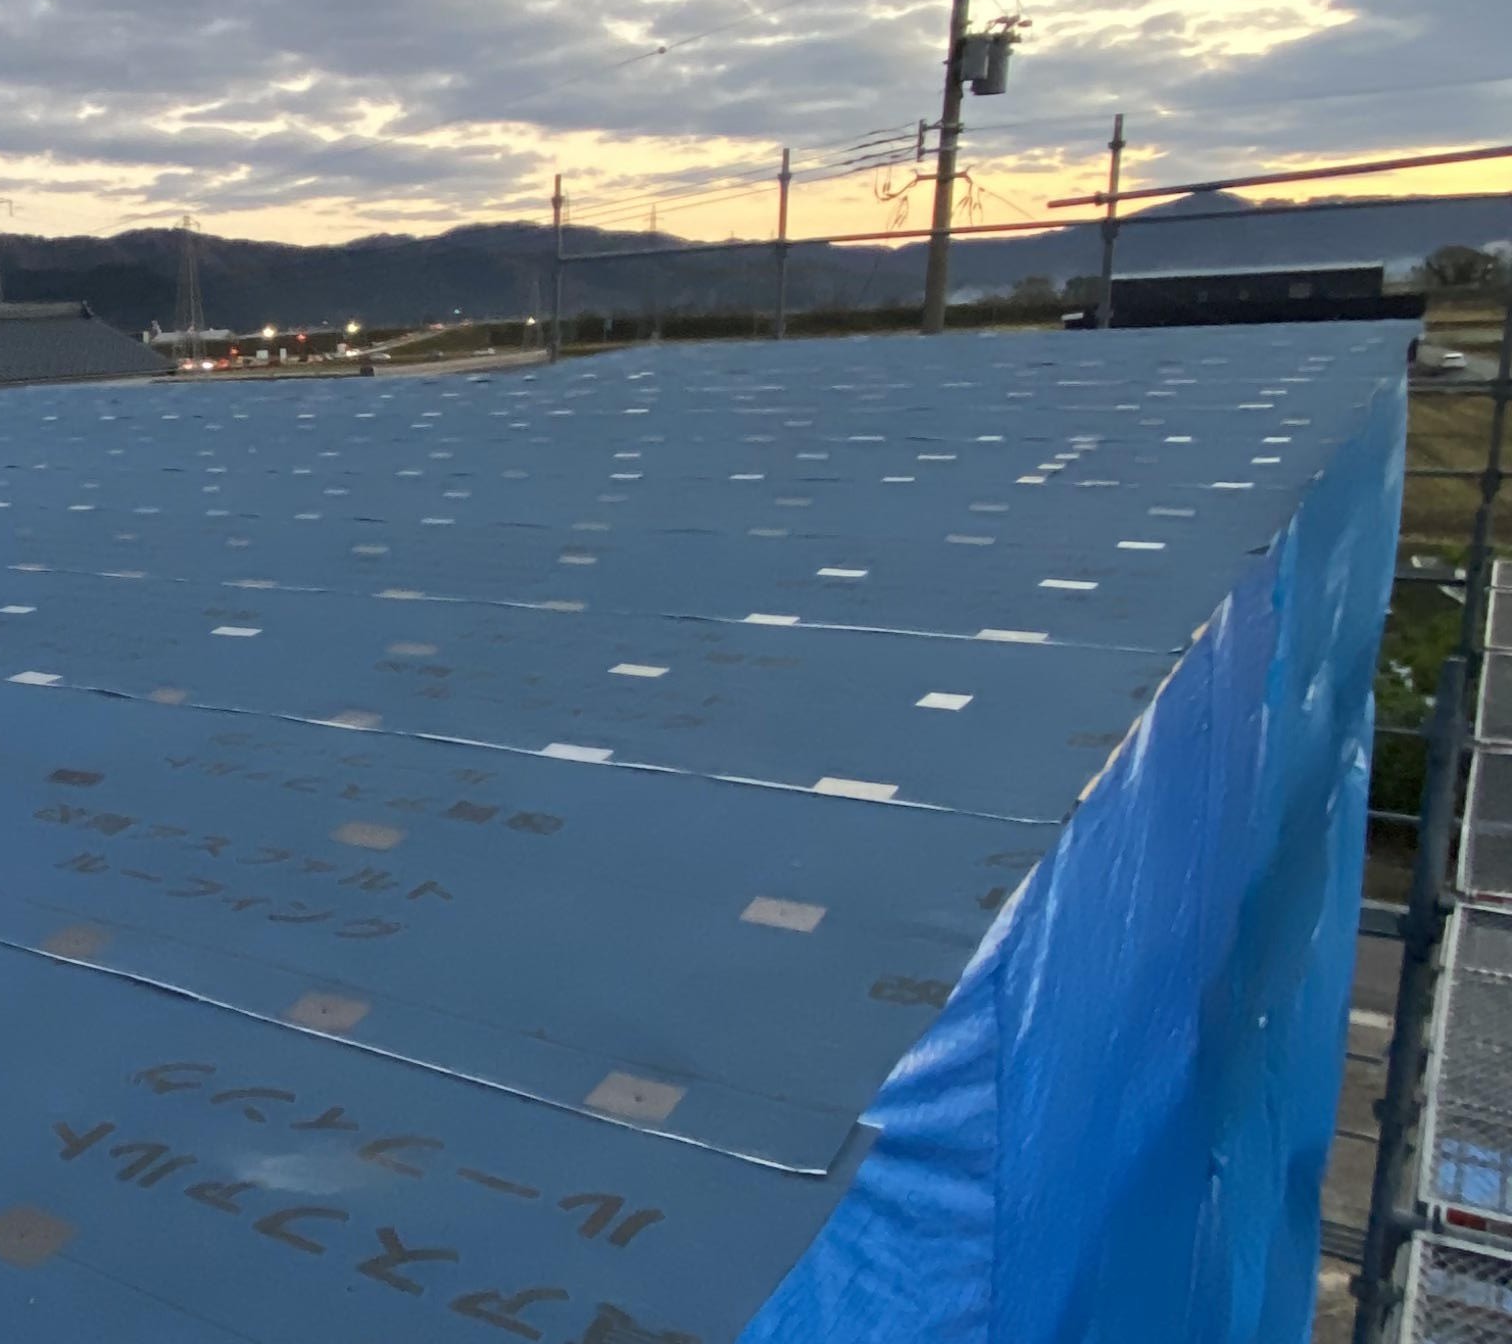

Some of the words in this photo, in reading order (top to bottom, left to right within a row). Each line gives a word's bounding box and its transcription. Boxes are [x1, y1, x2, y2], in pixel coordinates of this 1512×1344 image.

[128, 1060, 666, 1248] ルーフィング
